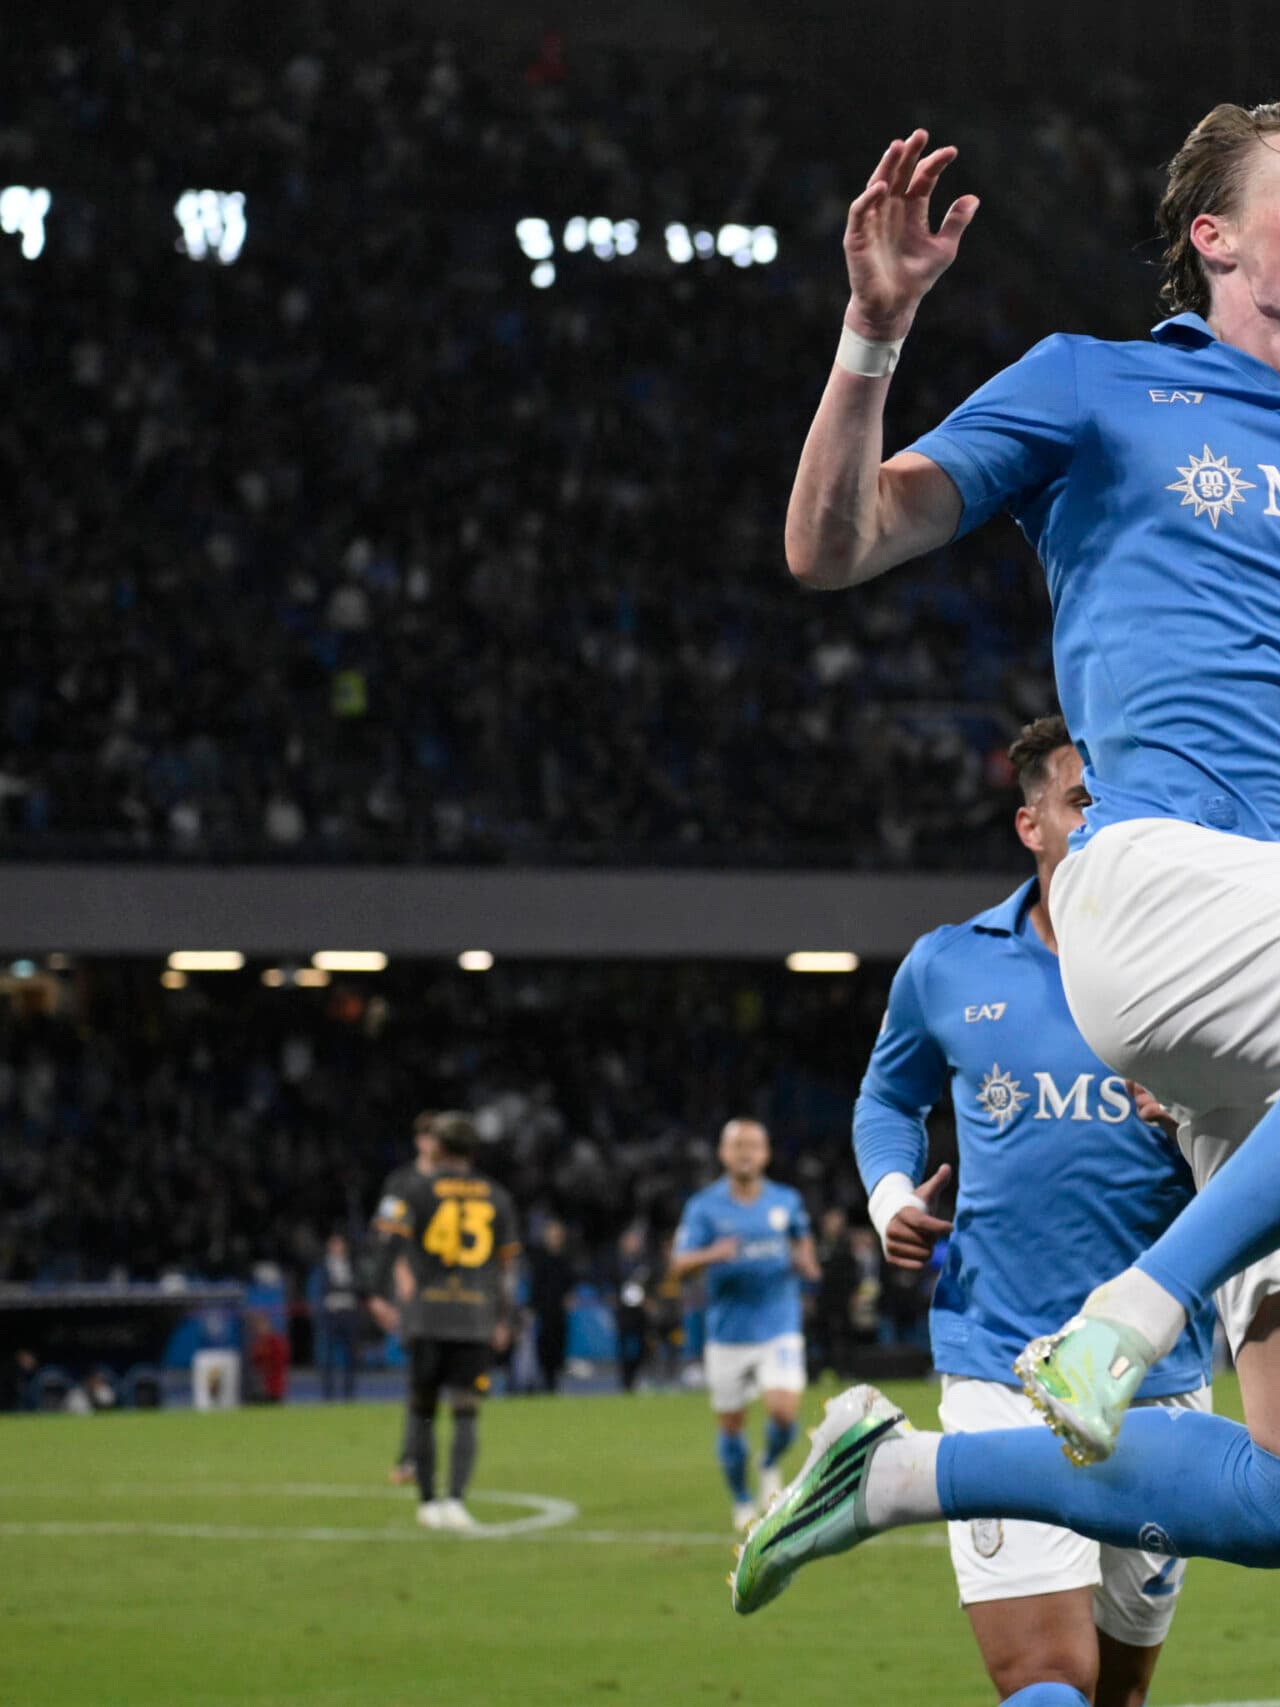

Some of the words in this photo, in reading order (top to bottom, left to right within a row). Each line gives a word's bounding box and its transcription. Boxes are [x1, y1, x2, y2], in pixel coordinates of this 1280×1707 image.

[1149, 390, 1205, 404] EA7
[964, 1002, 1008, 1024] EA7
[1033, 1072, 1131, 1124] MS
[1141, 1557, 1184, 1596] 2
